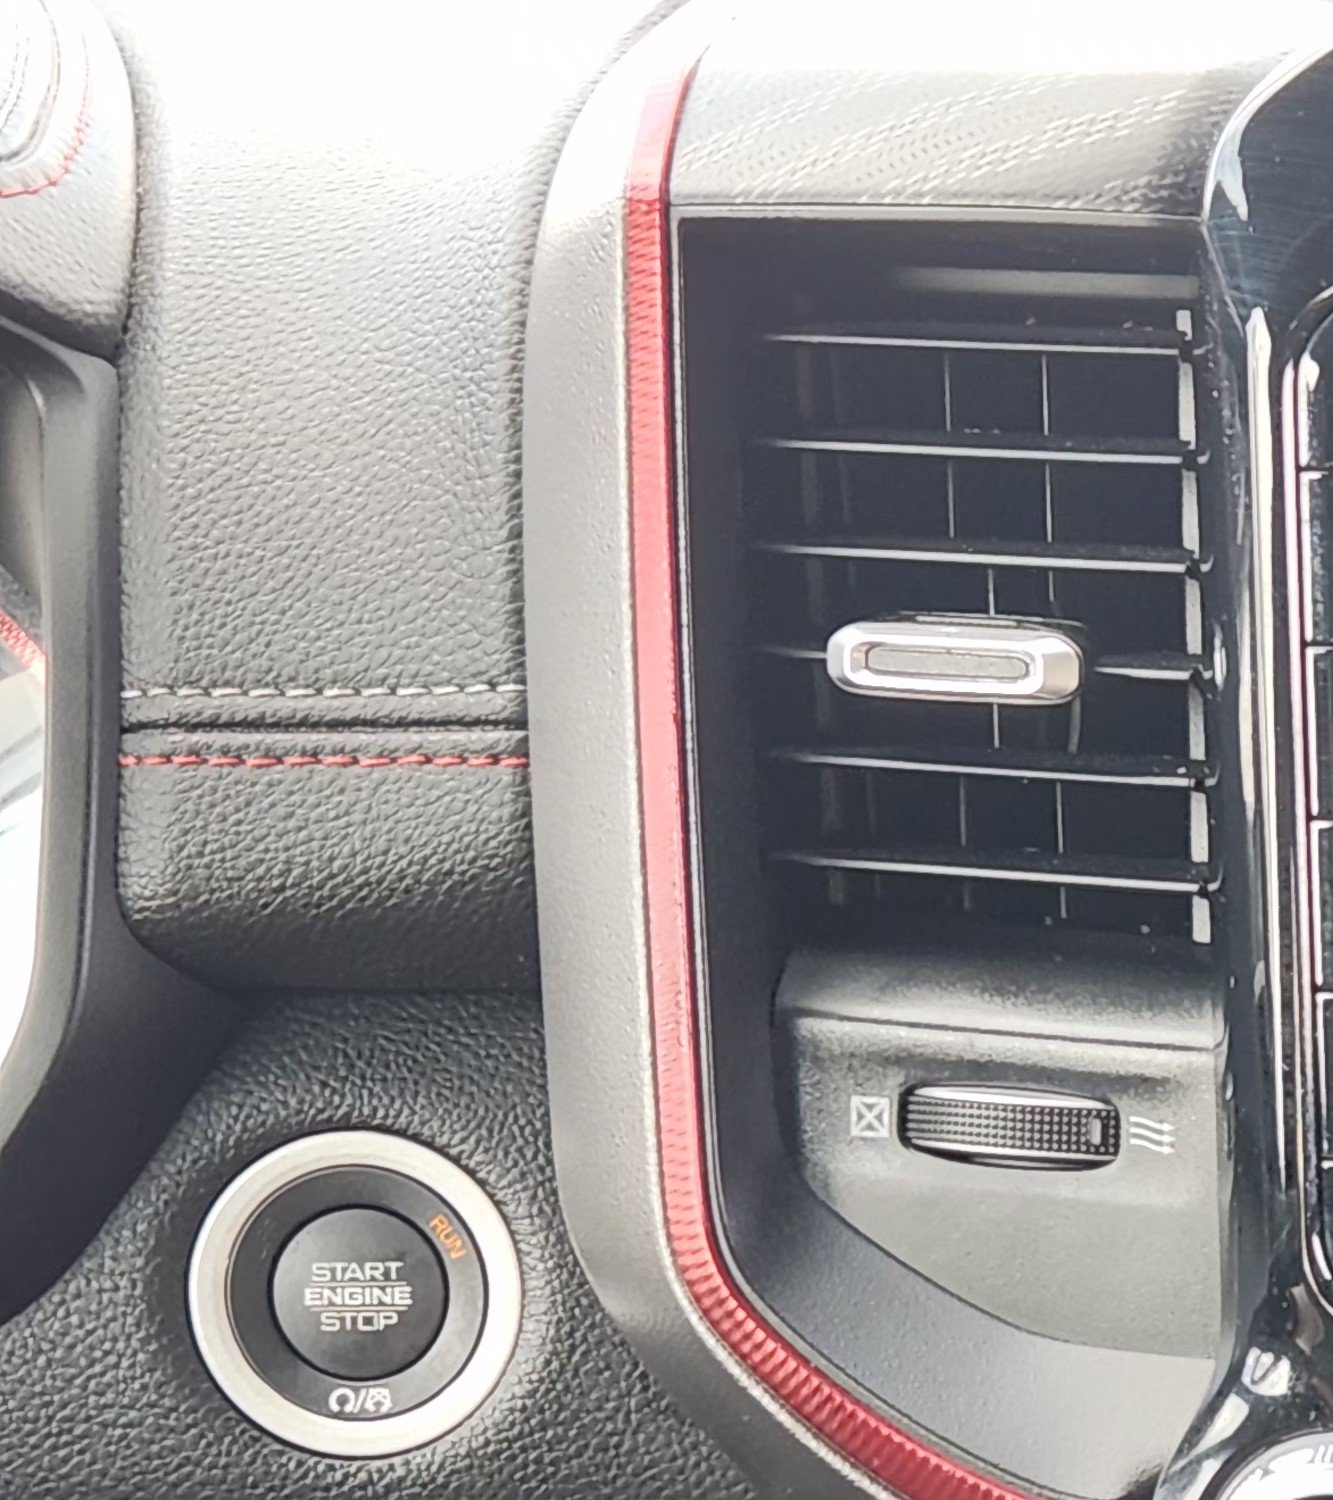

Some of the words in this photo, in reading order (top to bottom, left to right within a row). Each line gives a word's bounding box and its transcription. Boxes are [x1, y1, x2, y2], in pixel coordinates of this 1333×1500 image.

[428, 1213, 467, 1259] RUN
[312, 1261, 404, 1281] START
[304, 1286, 413, 1306] ENGINE
[320, 1311, 398, 1331] STOP
